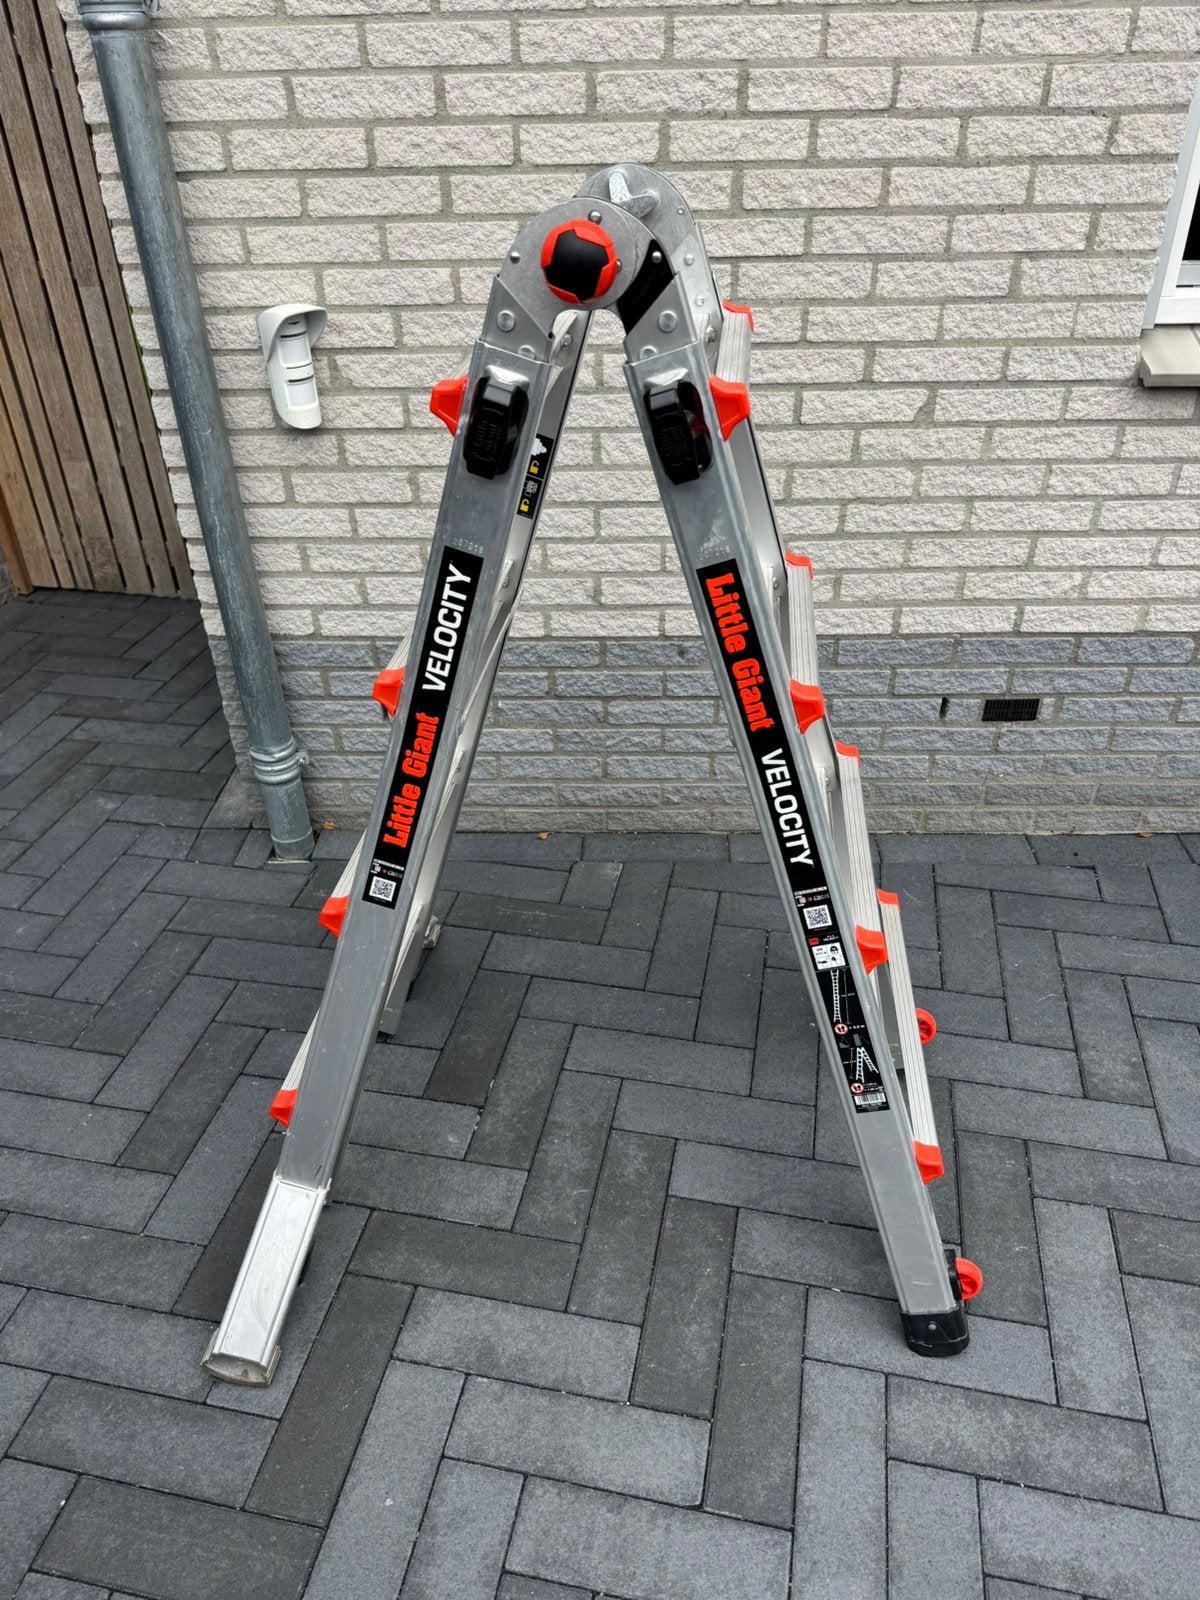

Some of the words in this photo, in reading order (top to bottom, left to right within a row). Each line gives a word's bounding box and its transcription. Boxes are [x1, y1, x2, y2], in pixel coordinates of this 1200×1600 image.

[383, 784, 421, 848] Little
[402, 712, 439, 778] Giant
[422, 563, 472, 692] VELOCITY
[705, 572, 748, 654] Little
[731, 658, 775, 732] Giant
[761, 748, 814, 867] VELOCITY
